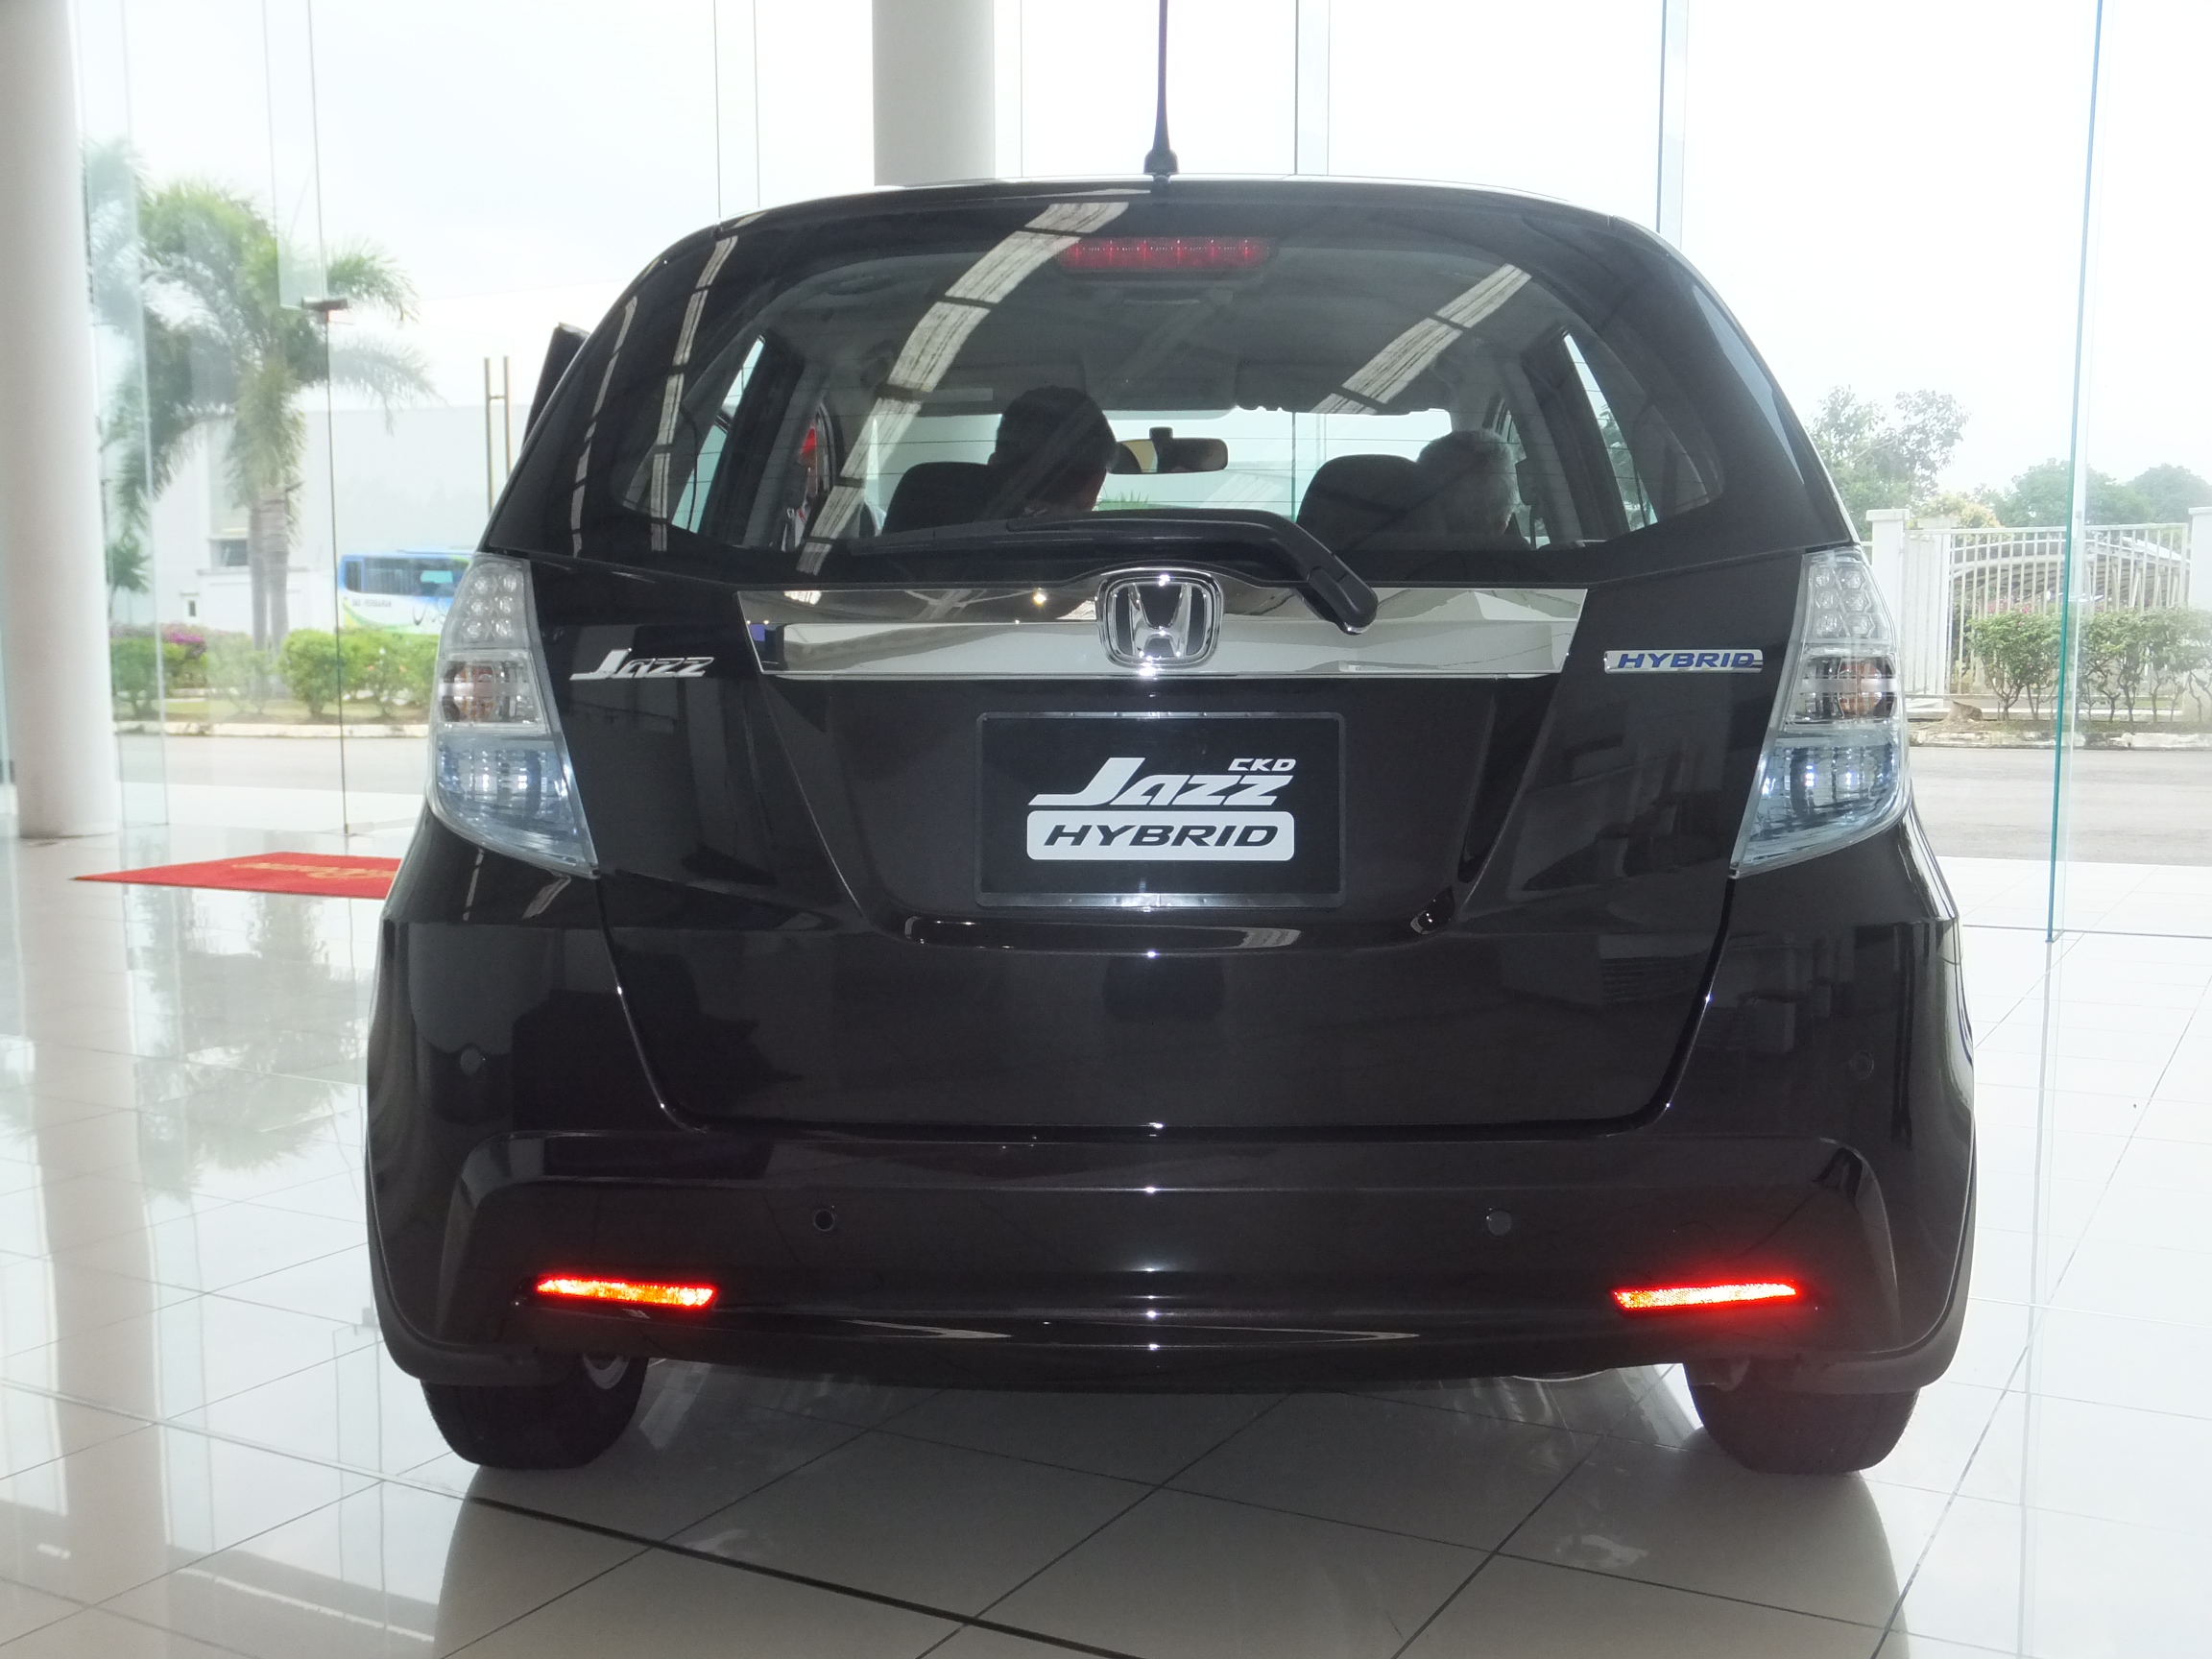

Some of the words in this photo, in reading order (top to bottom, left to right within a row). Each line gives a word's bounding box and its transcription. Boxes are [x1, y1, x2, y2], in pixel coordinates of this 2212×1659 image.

[1618, 653, 1755, 668] HYBRID
[1228, 758, 1296, 771] CKD
[1044, 825, 1279, 847] HYBRID
